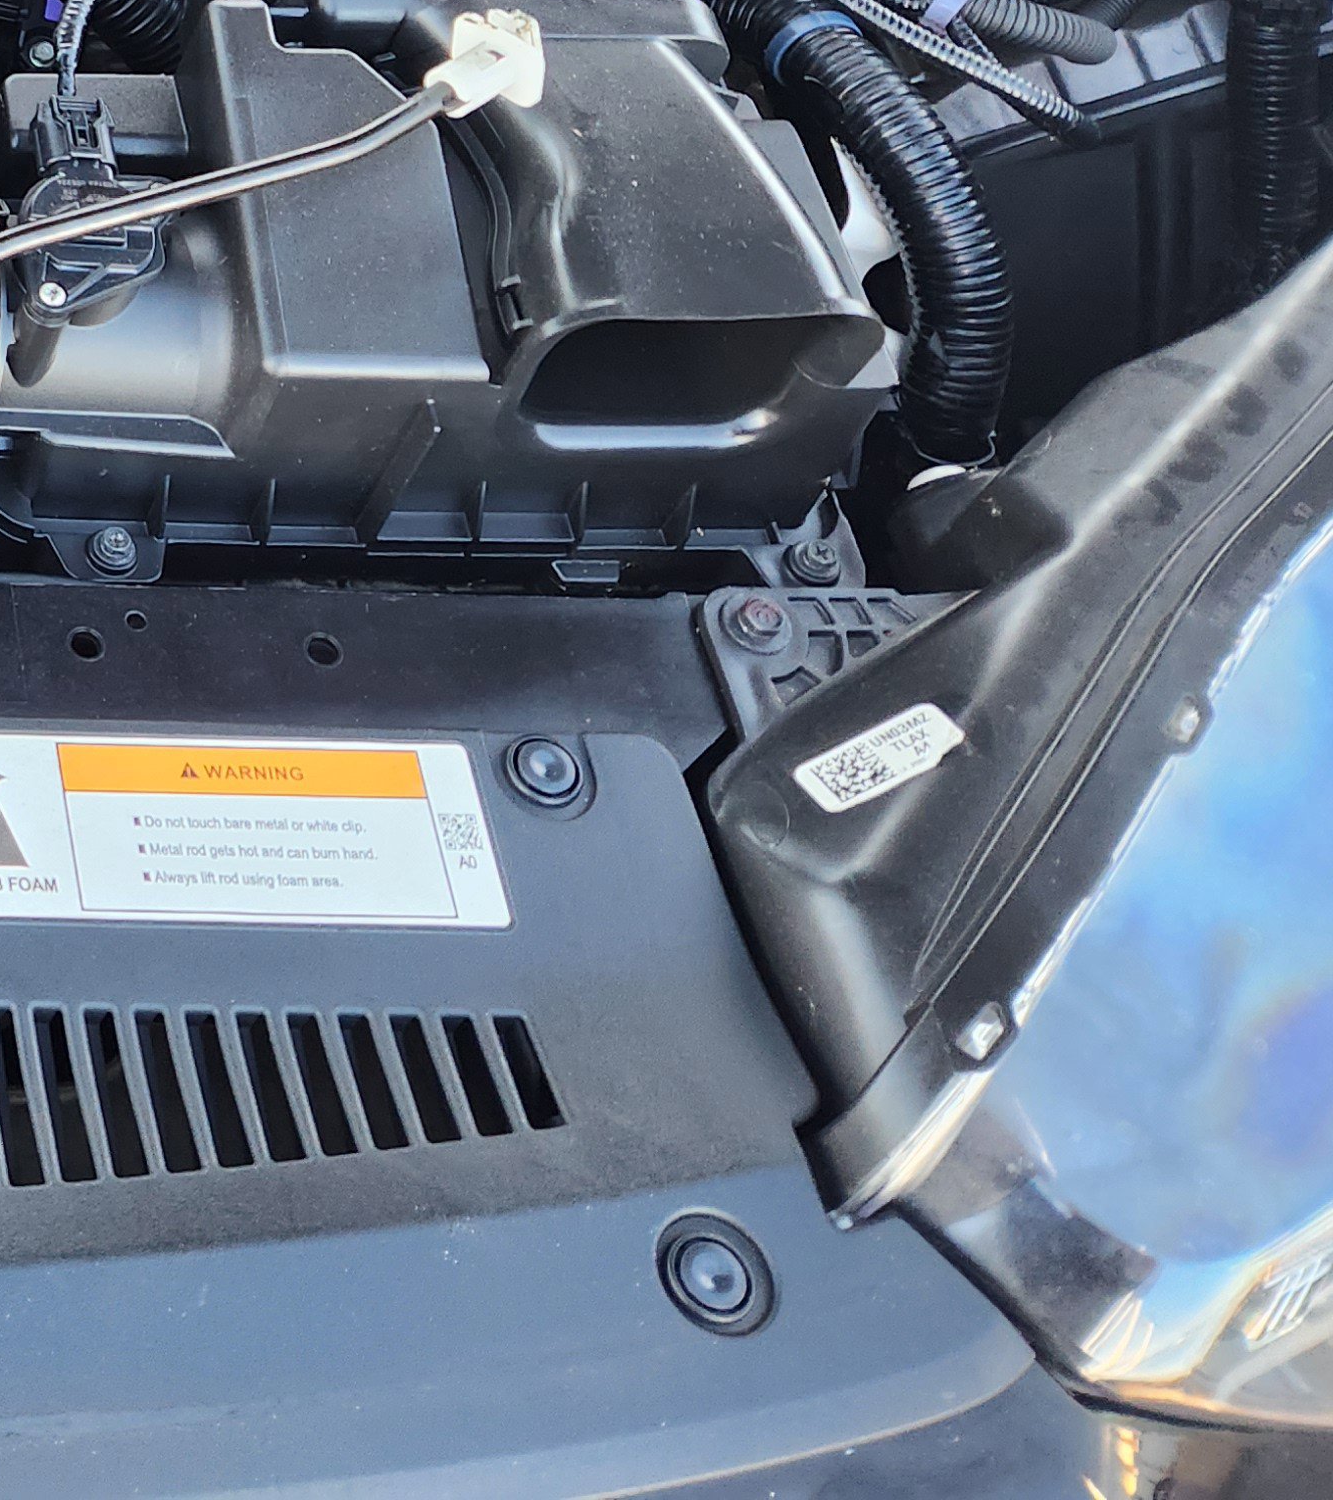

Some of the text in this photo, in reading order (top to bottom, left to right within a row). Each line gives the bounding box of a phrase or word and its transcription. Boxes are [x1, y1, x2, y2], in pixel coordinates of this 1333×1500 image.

[889, 727, 931, 752] TLAX
[204, 763, 305, 782] WARNING
[144, 815, 162, 828] Do
[165, 816, 184, 829] not
[187, 816, 221, 829] touch
[224, 817, 252, 830] bare
[255, 818, 289, 831] metal
[291, 820, 303, 831] or
[307, 819, 338, 832] white
[149, 843, 183, 856] Metal
[186, 844, 207, 856] rod
[209, 845, 236, 859] gets
[238, 845, 259, 857] hot
[262, 846, 284, 858] and
[287, 848, 310, 859] can
[312, 846, 340, 860] burn
[8, 876, 58, 894] FOAM
[155, 871, 198, 887] Always
[200, 871, 216, 884] lift
[219, 872, 239, 885] rod
[242, 873, 274, 889] using
[277, 874, 308, 887] foam
